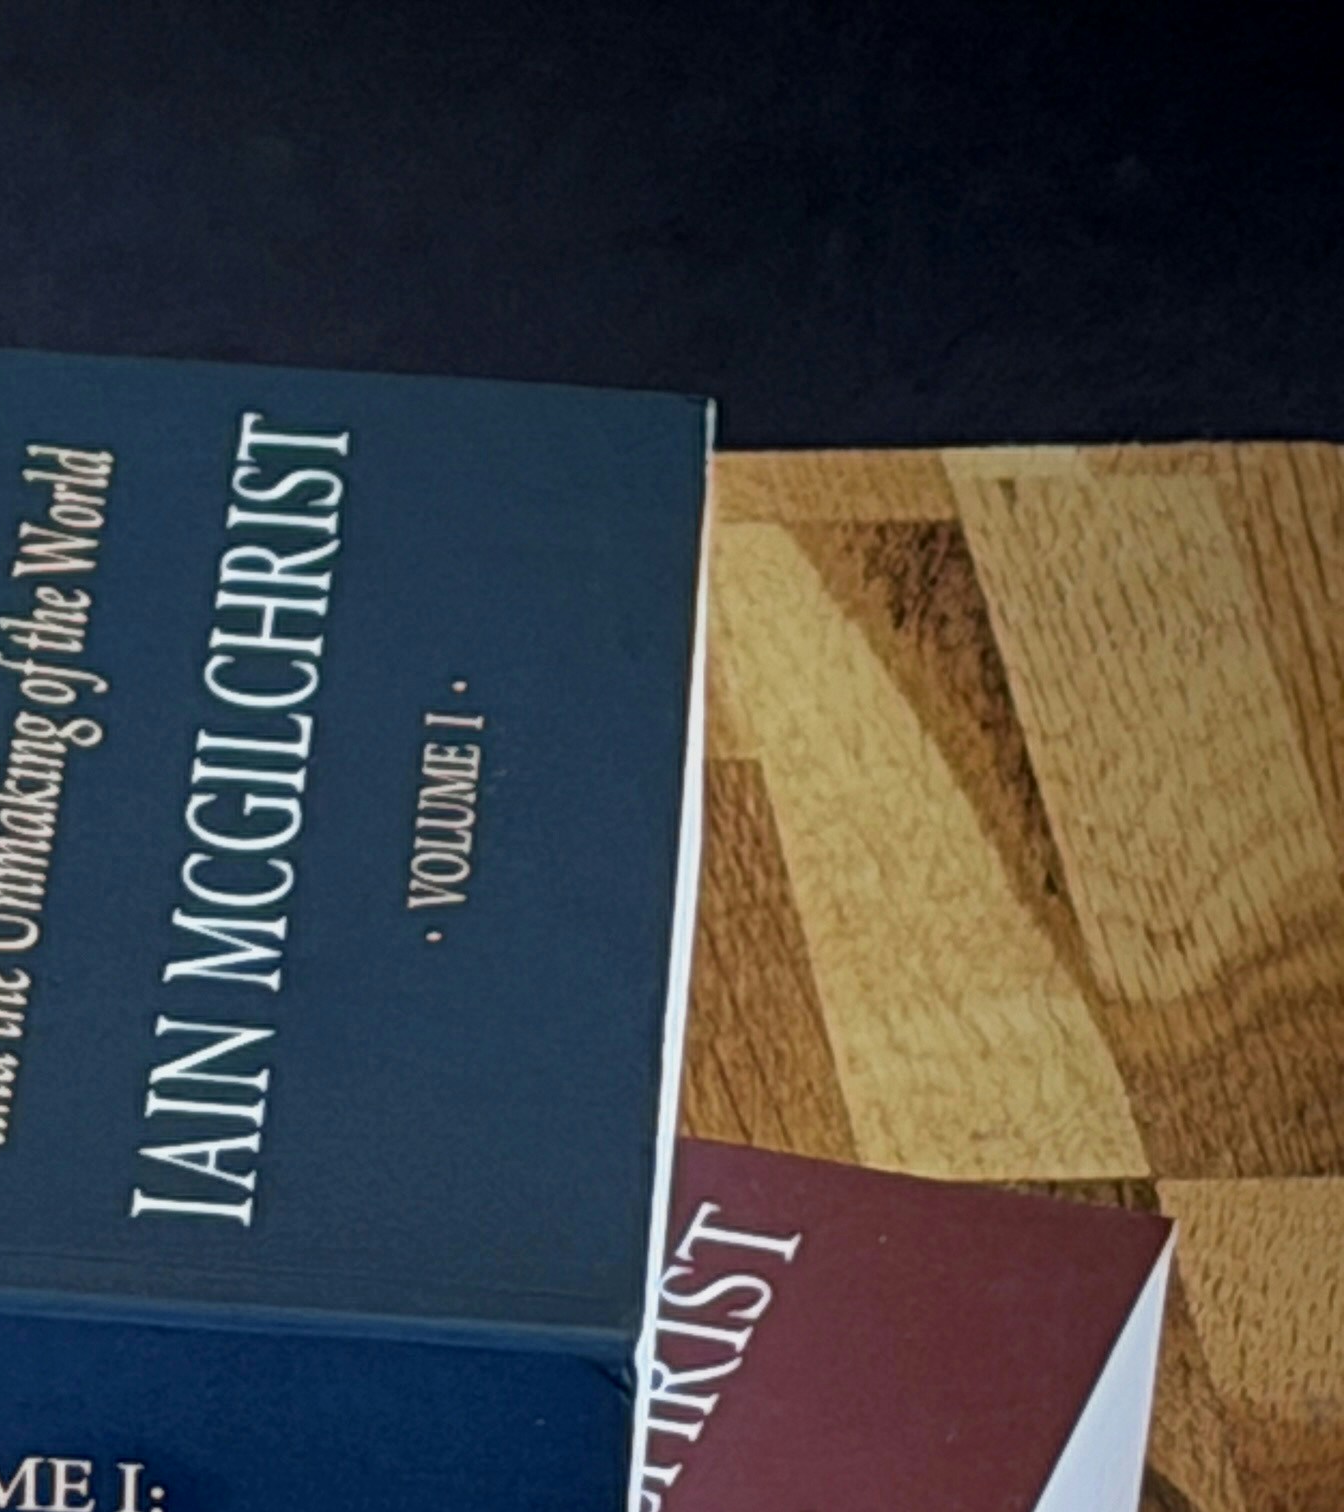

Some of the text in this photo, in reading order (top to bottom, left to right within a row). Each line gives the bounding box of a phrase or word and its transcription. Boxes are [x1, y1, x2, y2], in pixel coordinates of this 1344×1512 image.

[11, 444, 114, 577] World
[407, 713, 484, 909] VOLUME I
[131, 1015, 274, 1226] IAIN
